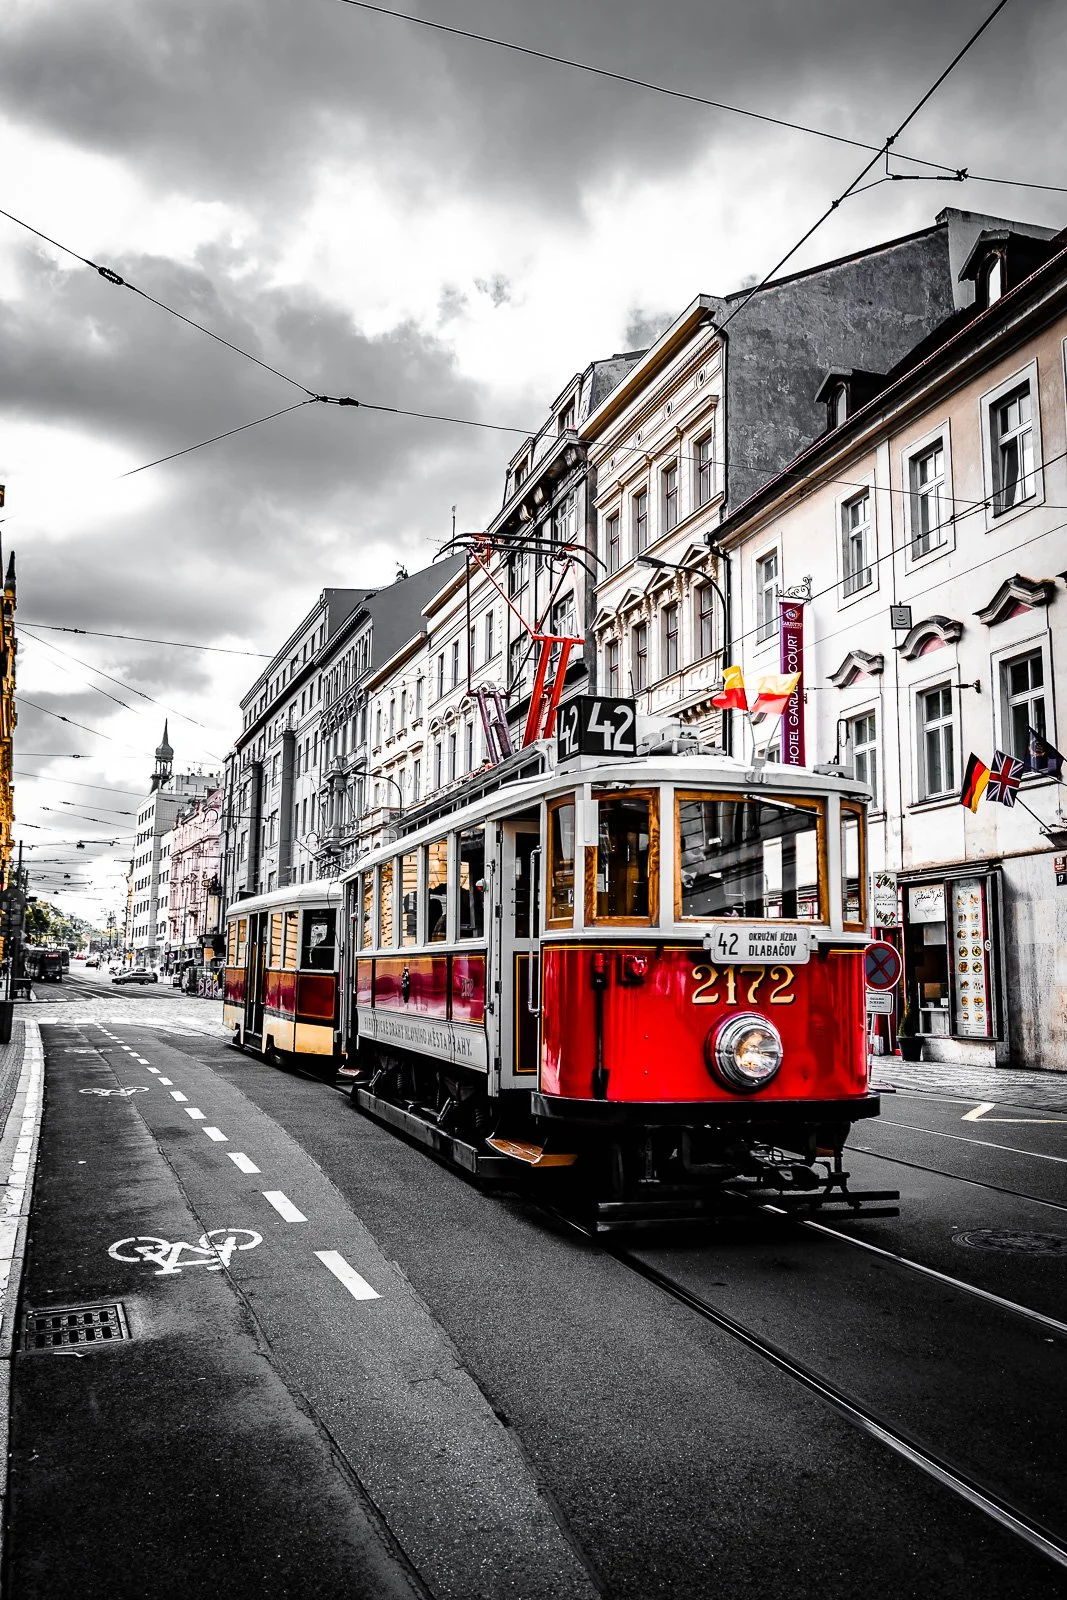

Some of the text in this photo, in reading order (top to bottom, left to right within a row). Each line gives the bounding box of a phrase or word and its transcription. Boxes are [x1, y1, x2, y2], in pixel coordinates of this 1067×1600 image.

[788, 634, 798, 674] COURT
[559, 705, 579, 755] 42
[587, 702, 634, 752] 42
[789, 729, 799, 764] HOTEL
[718, 932, 739, 956] 42
[748, 932, 797, 942] OKRUŽNÍ JÍZDA
[748, 943, 797, 957] DLABAČOV
[691, 964, 796, 1005] 2172
